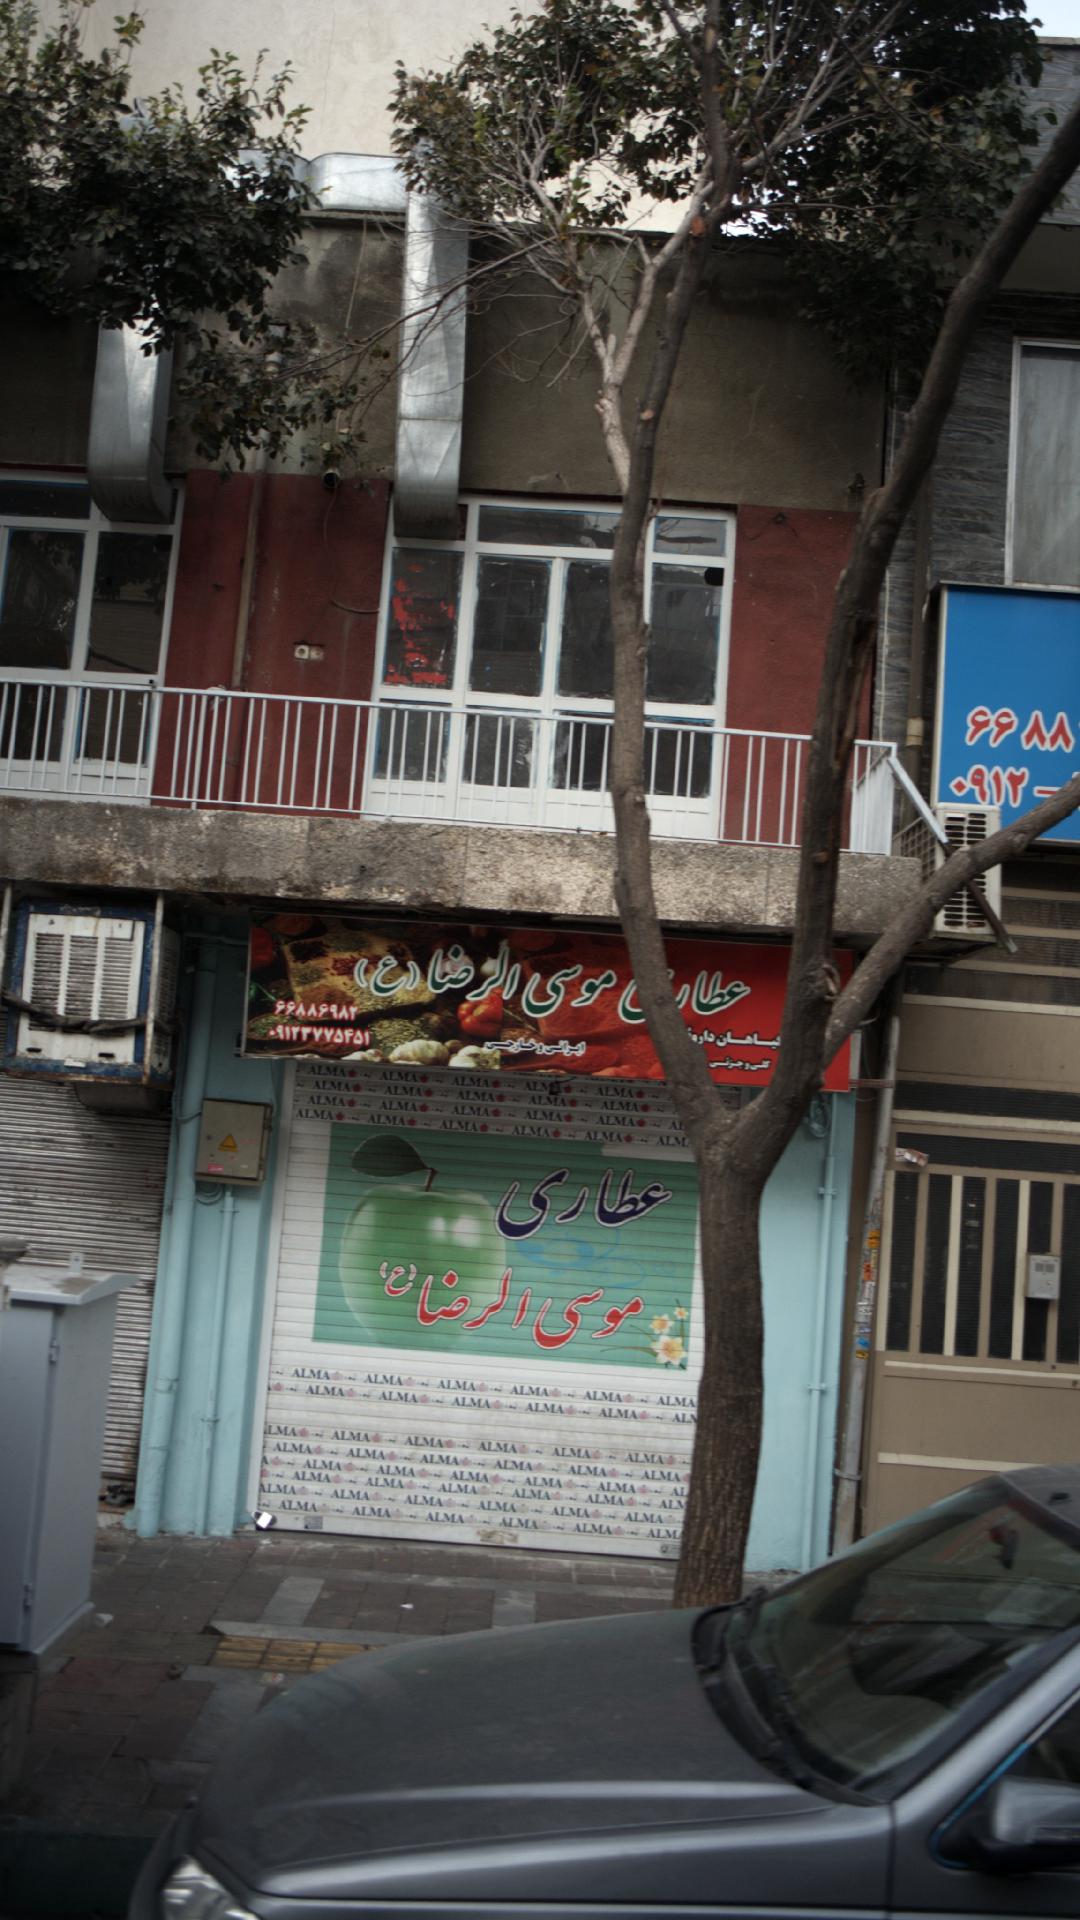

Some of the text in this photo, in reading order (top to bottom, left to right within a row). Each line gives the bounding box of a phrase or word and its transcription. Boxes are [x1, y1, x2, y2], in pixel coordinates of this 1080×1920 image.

[427, 940, 521, 1000] الرضا
[522, 964, 616, 1018] موسی
[308, 1065, 346, 1078] ALMA
[381, 1070, 417, 1083] ALMA
[453, 1076, 489, 1087] ALMA
[597, 1086, 633, 1098] ALMA
[314, 1080, 350, 1092] ALMA
[384, 1085, 422, 1097] ALMA
[458, 1090, 495, 1102] ALMA
[529, 1094, 566, 1107] ALMA
[602, 1100, 638, 1112] ALMA
[296, 1108, 333, 1121] ALMA
[368, 1114, 405, 1126] ALMA
[439, 1119, 478, 1132] ALMA
[512, 1126, 549, 1138] ALMA
[584, 1131, 622, 1143] ALMA
[657, 1136, 689, 1147] ALM
[309, 1095, 346, 1107] ALMA
[381, 1100, 417, 1112] ALMA
[453, 1105, 489, 1117] ALMA
[525, 1110, 562, 1122] ALMA
[596, 1115, 634, 1127] ALMA
[669, 1121, 685, 1131] AL
[494, 1167, 673, 1239] عطاری
[417, 1266, 532, 1330] الرضا
[532, 1287, 645, 1350] موسی
[291, 1368, 330, 1380] ALMA
[364, 1374, 403, 1386] ALMA
[437, 1380, 476, 1391] ALMA
[510, 1385, 550, 1397] ALMA
[583, 1391, 622, 1403] ALMA
[657, 1396, 696, 1408] ALMA
[306, 1385, 344, 1397] ALMA
[379, 1391, 418, 1403] ALMA
[452, 1397, 490, 1409] ALMA
[525, 1403, 564, 1414] ALMA
[599, 1408, 637, 1420] ALMA
[673, 1413, 697, 1423] ALM
[273, 1442, 312, 1454] ALMA
[347, 1448, 385, 1461] ALMA
[420, 1454, 459, 1466] ALMA
[494, 1460, 533, 1472] ALMA
[568, 1466, 607, 1478] ALMA
[642, 1471, 680, 1482] ALMA
[331, 1431, 370, 1442] ALMA
[405, 1436, 444, 1448] ALMA
[478, 1442, 517, 1453] ALMA
[552, 1447, 591, 1459] ALMA
[625, 1453, 664, 1465] ALMA
[292, 1472, 330, 1484] ALMA
[365, 1478, 404, 1489] ALMA
[438, 1484, 477, 1495] ALMA
[512, 1489, 550, 1500] ALMA
[585, 1494, 625, 1506] ALMA
[659, 1500, 687, 1510] ALM
[303, 1459, 342, 1471] ALMA
[376, 1465, 415, 1477] ALMA
[450, 1471, 488, 1483] ALMA
[524, 1477, 562, 1488] ALMA
[598, 1482, 636, 1494] ALMA
[671, 1488, 688, 1497] AL
[260, 1484, 296, 1495] ALMA
[330, 1490, 369, 1501] ALMA
[404, 1495, 443, 1507] ALMA
[477, 1502, 516, 1513] ALMA
[551, 1507, 590, 1518] ALMA
[624, 1512, 663, 1524] ALMA
[279, 1501, 317, 1513] ALMA
[352, 1507, 391, 1518] ALMA
[426, 1513, 465, 1524] ALMA
[501, 1518, 538, 1530] ALMA
[574, 1524, 612, 1535] ALMA
[647, 1528, 681, 1539] ALM
